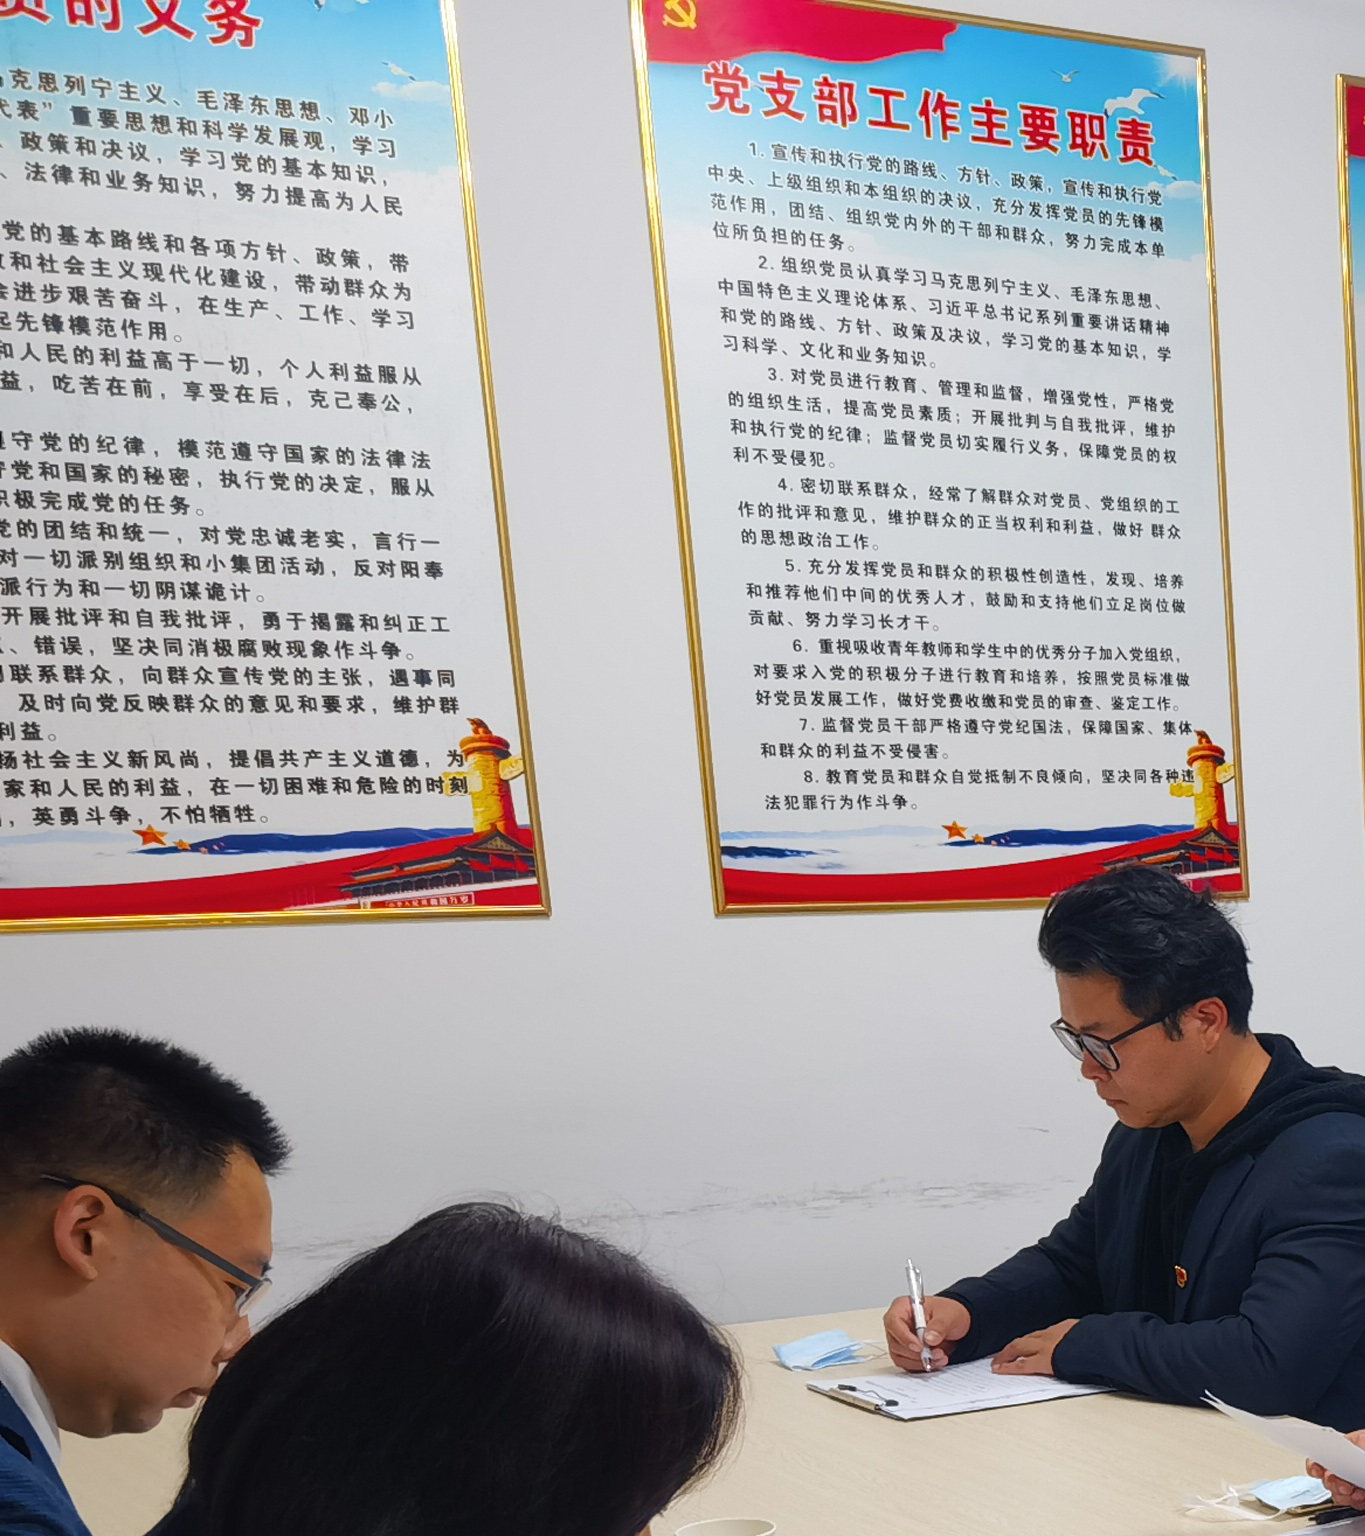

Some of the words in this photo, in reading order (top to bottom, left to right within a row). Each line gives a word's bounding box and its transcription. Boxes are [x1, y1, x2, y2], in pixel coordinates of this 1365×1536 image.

[0, 67, 393, 129] 克思列宁主义、毛泽东思想、邓小
[702, 60, 1157, 168] 党支部工作主要职责
[0, 250, 411, 302] 和社会主义现代化建设，带动群众为
[0, 429, 431, 470] 守党的纪律，模范遵守国家的法律法
[0, 458, 434, 497] 党和国家的秘密，执行党的决定，服从
[0, 634, 417, 660] 、错误，坚决同消极腐败现象作斗争。
[0, 663, 455, 688] 联系群众，向群众宣传党的主张，遇事同
[0, 805, 271, 827] ，英勇斗争，不怕牺牲。
